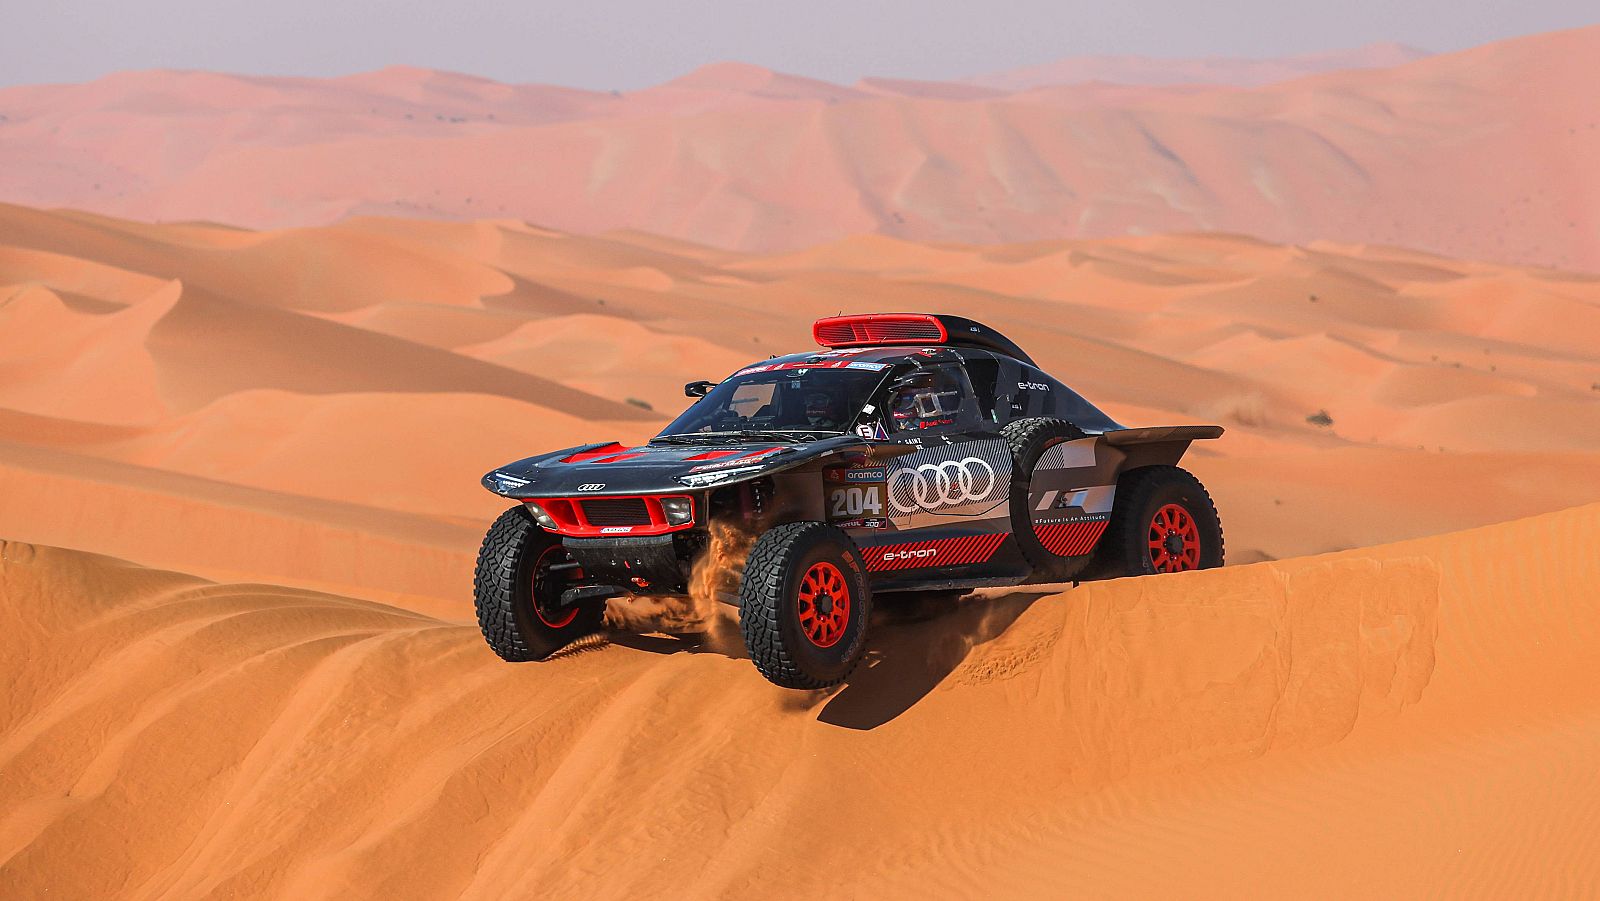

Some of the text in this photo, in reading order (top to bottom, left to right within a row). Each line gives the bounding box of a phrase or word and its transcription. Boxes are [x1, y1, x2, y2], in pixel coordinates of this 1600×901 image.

[1017, 381, 1050, 392] e-tron
[904, 437, 923, 445] SAINZ
[847, 471, 883, 479] aramco
[831, 486, 882, 516] 204
[883, 548, 937, 561] e-tron
